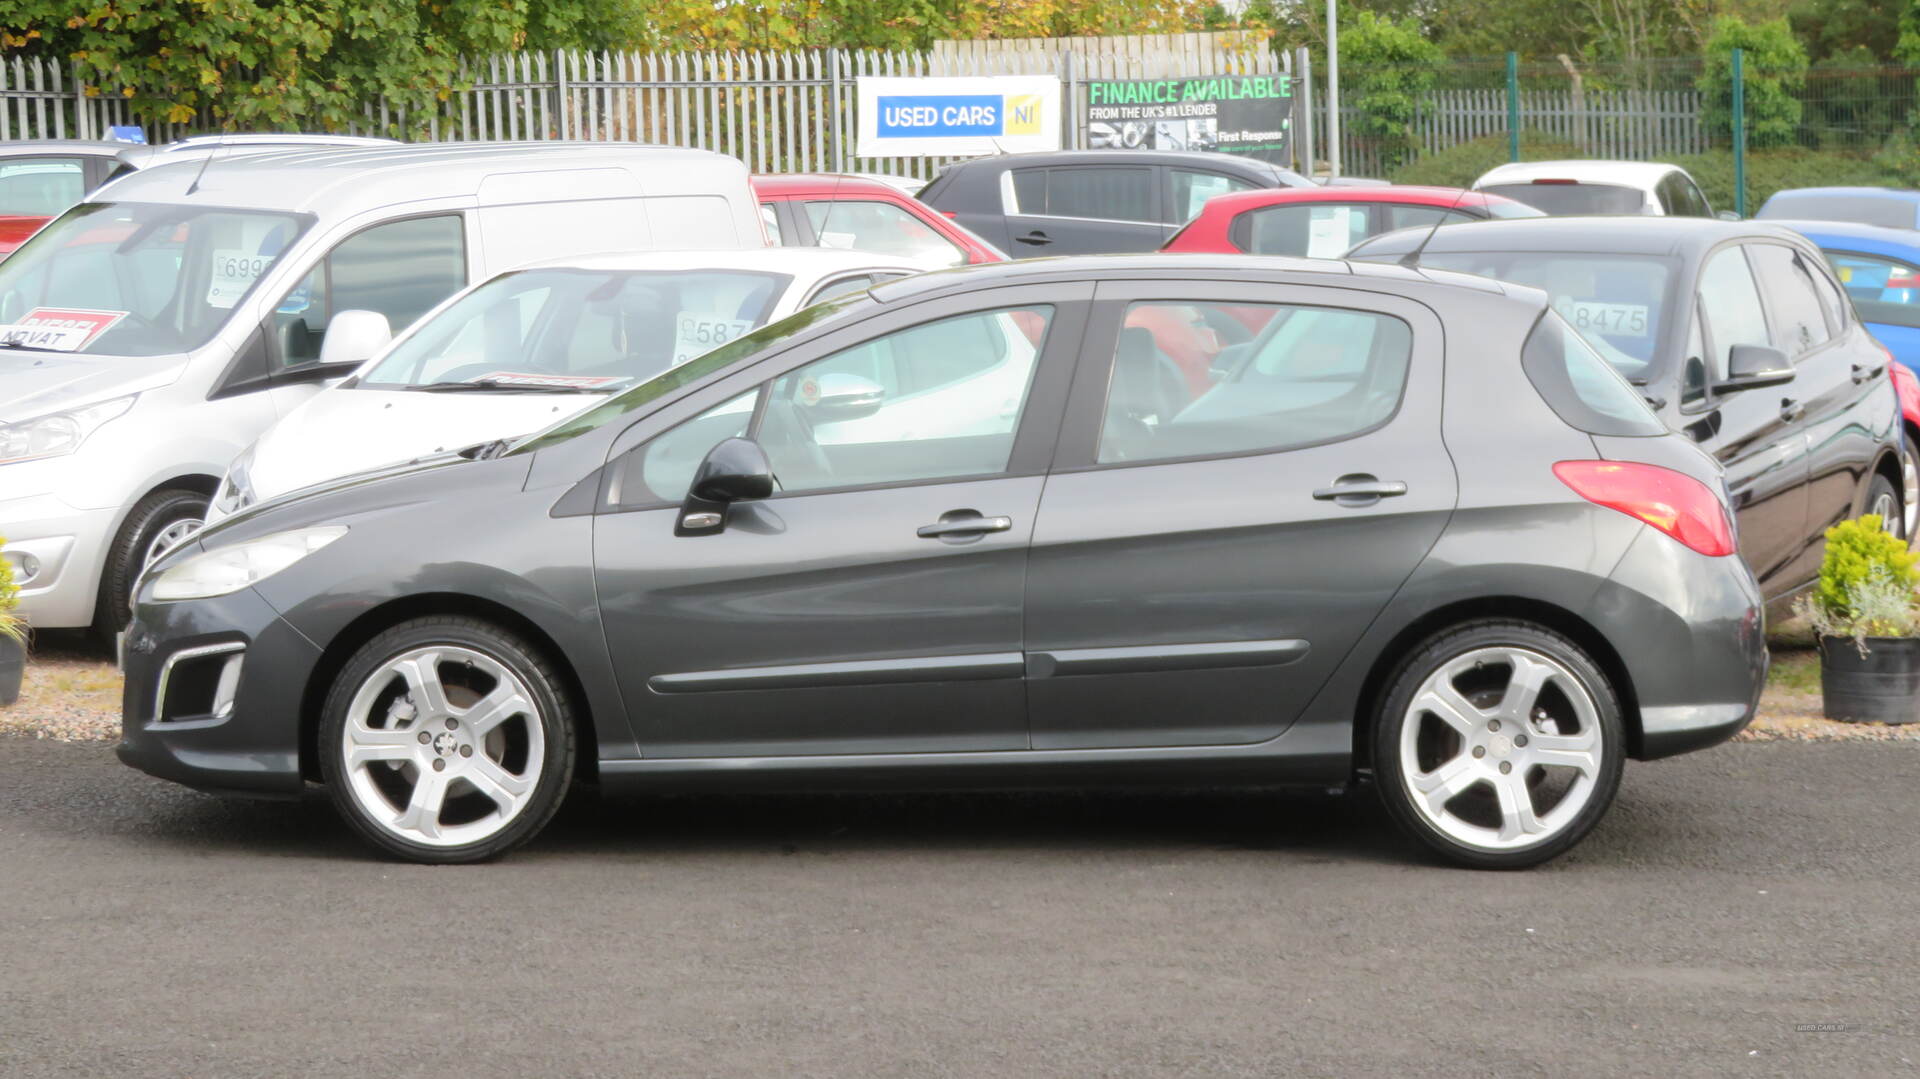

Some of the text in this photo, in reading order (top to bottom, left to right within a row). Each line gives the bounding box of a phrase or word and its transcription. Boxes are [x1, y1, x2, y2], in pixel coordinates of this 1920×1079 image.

[1090, 76, 1291, 104] FINANCE AVAILABLE
[885, 106, 1034, 127] USED CARS NI
[1089, 103, 1217, 119] FROM THE UK'S #1 LENDER
[1218, 130, 1283, 142] First Response
